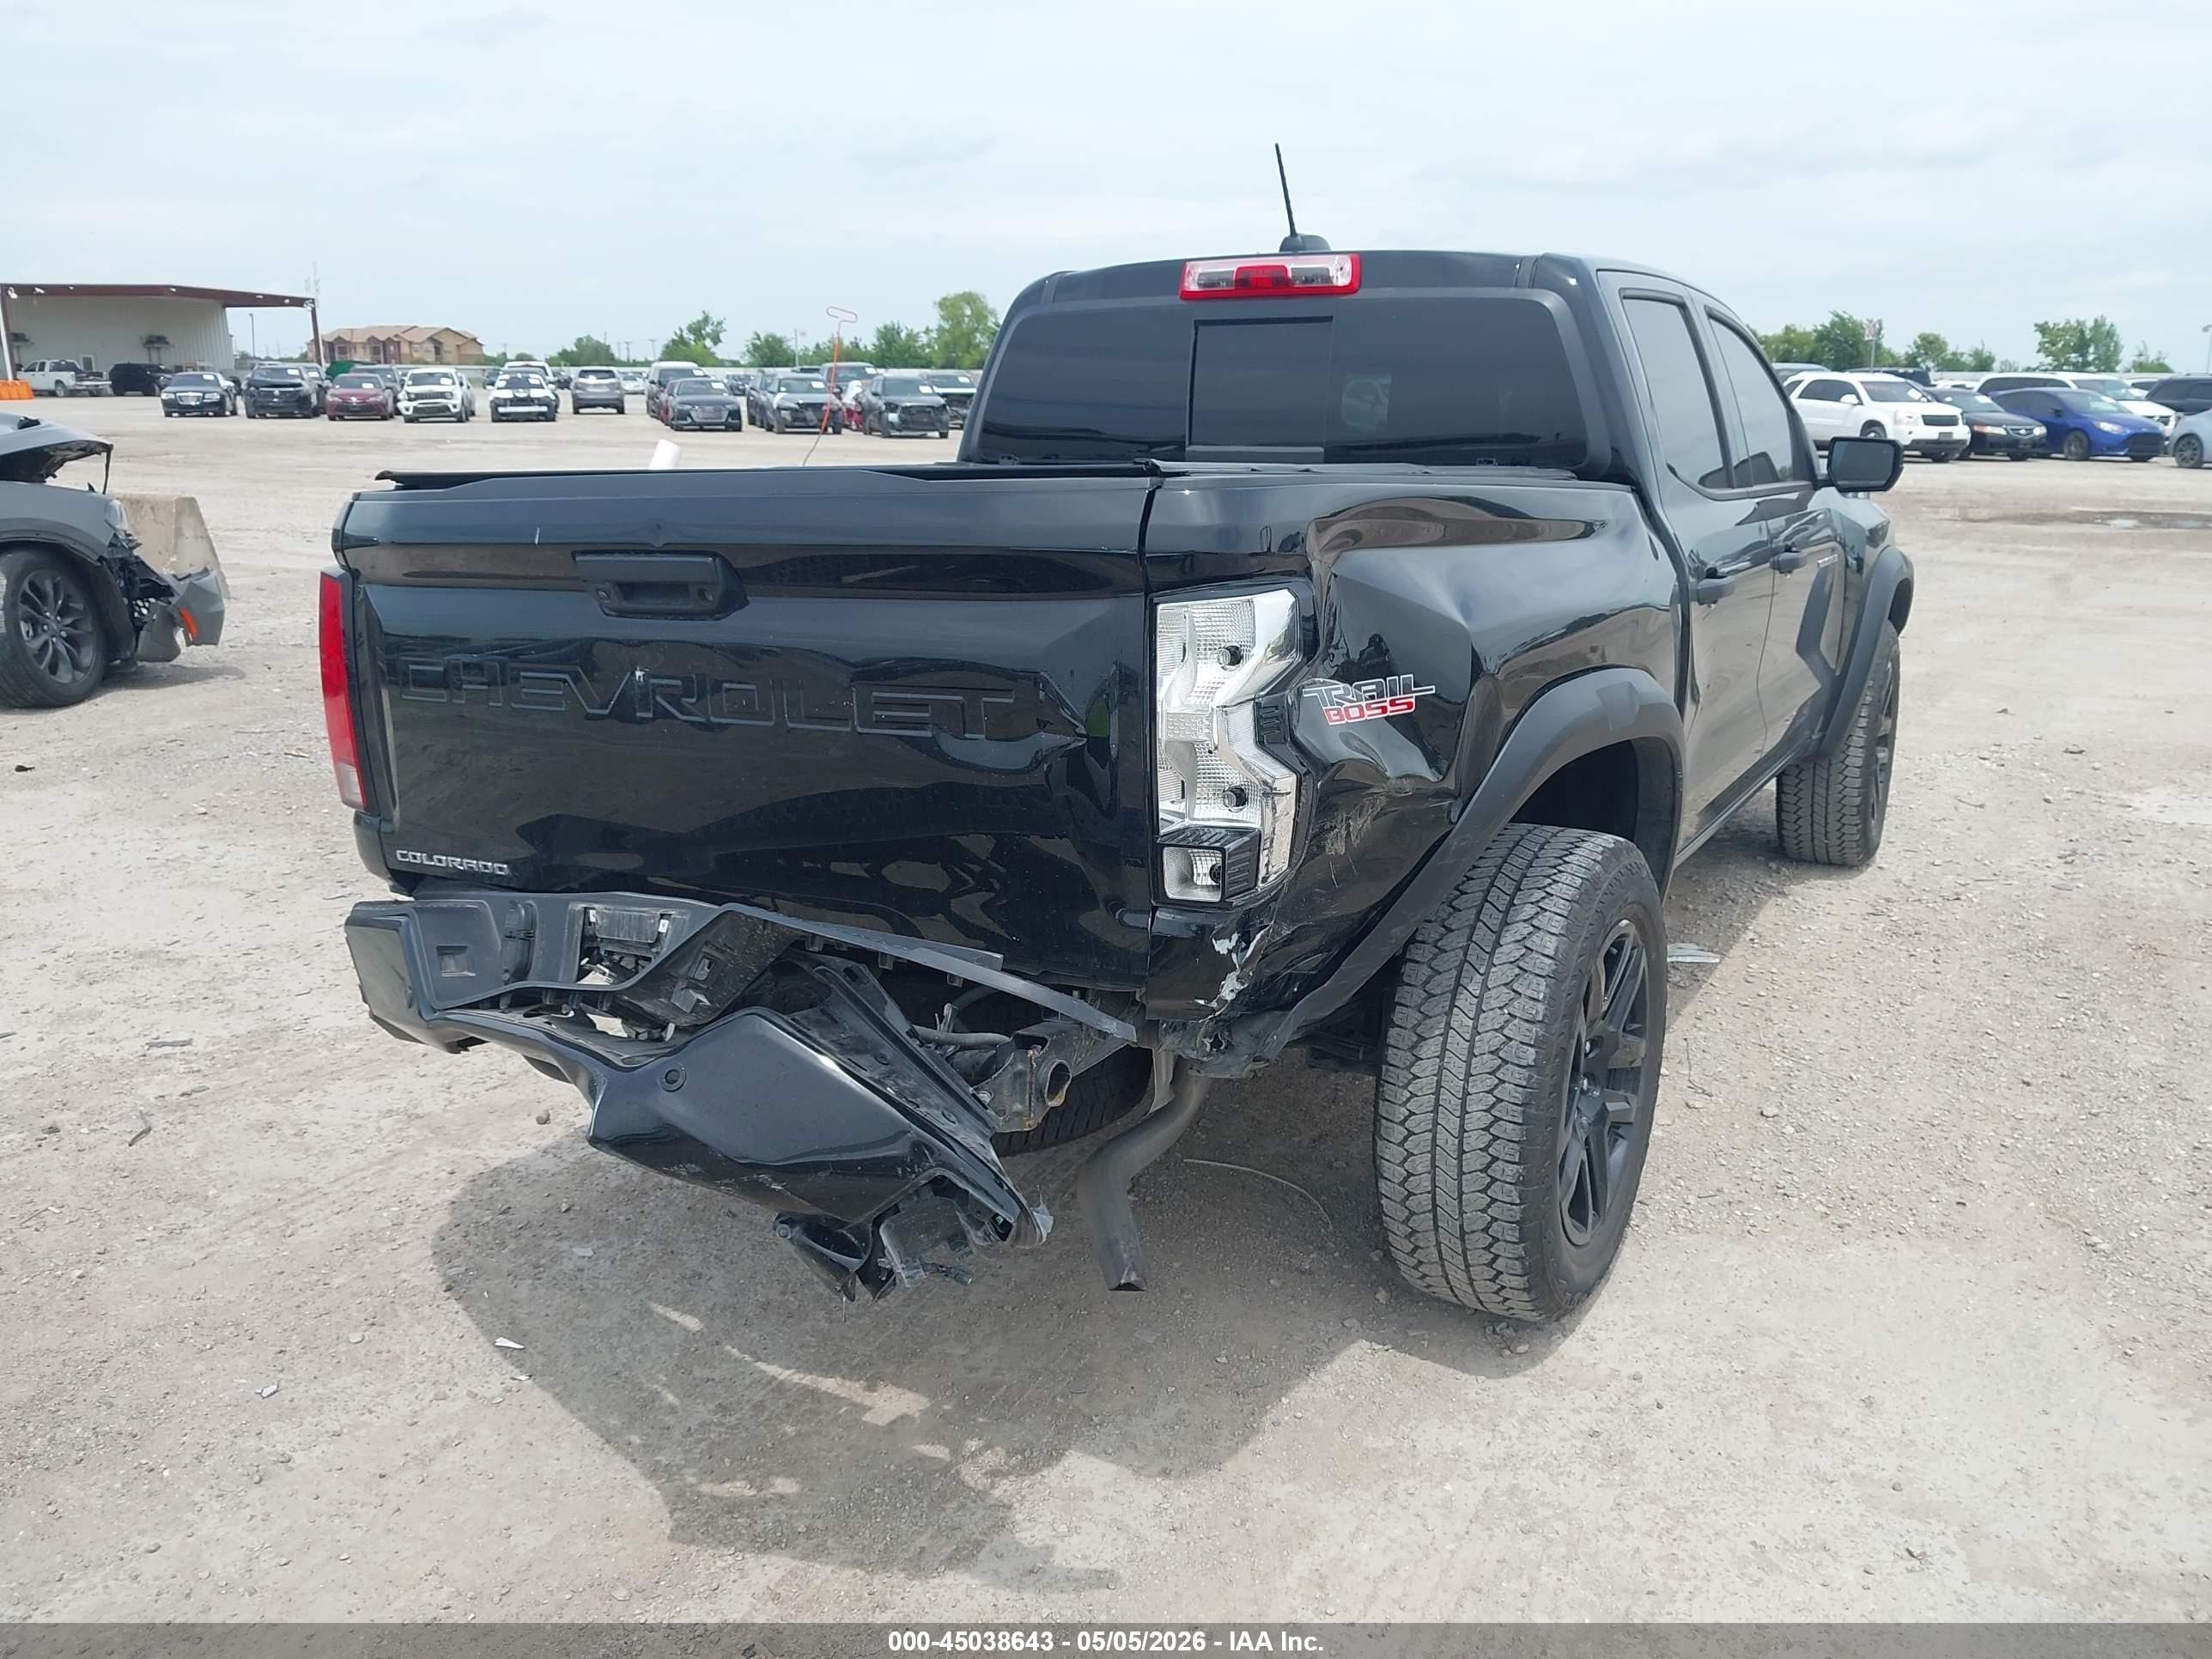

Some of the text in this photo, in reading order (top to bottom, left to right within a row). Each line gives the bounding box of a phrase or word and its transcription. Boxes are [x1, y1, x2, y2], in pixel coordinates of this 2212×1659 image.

[398, 657, 1015, 738] CHEVROLET
[1302, 674, 1436, 708] TRAIL
[1323, 696, 1415, 725] BOSS
[396, 849, 509, 875] COLORADO
